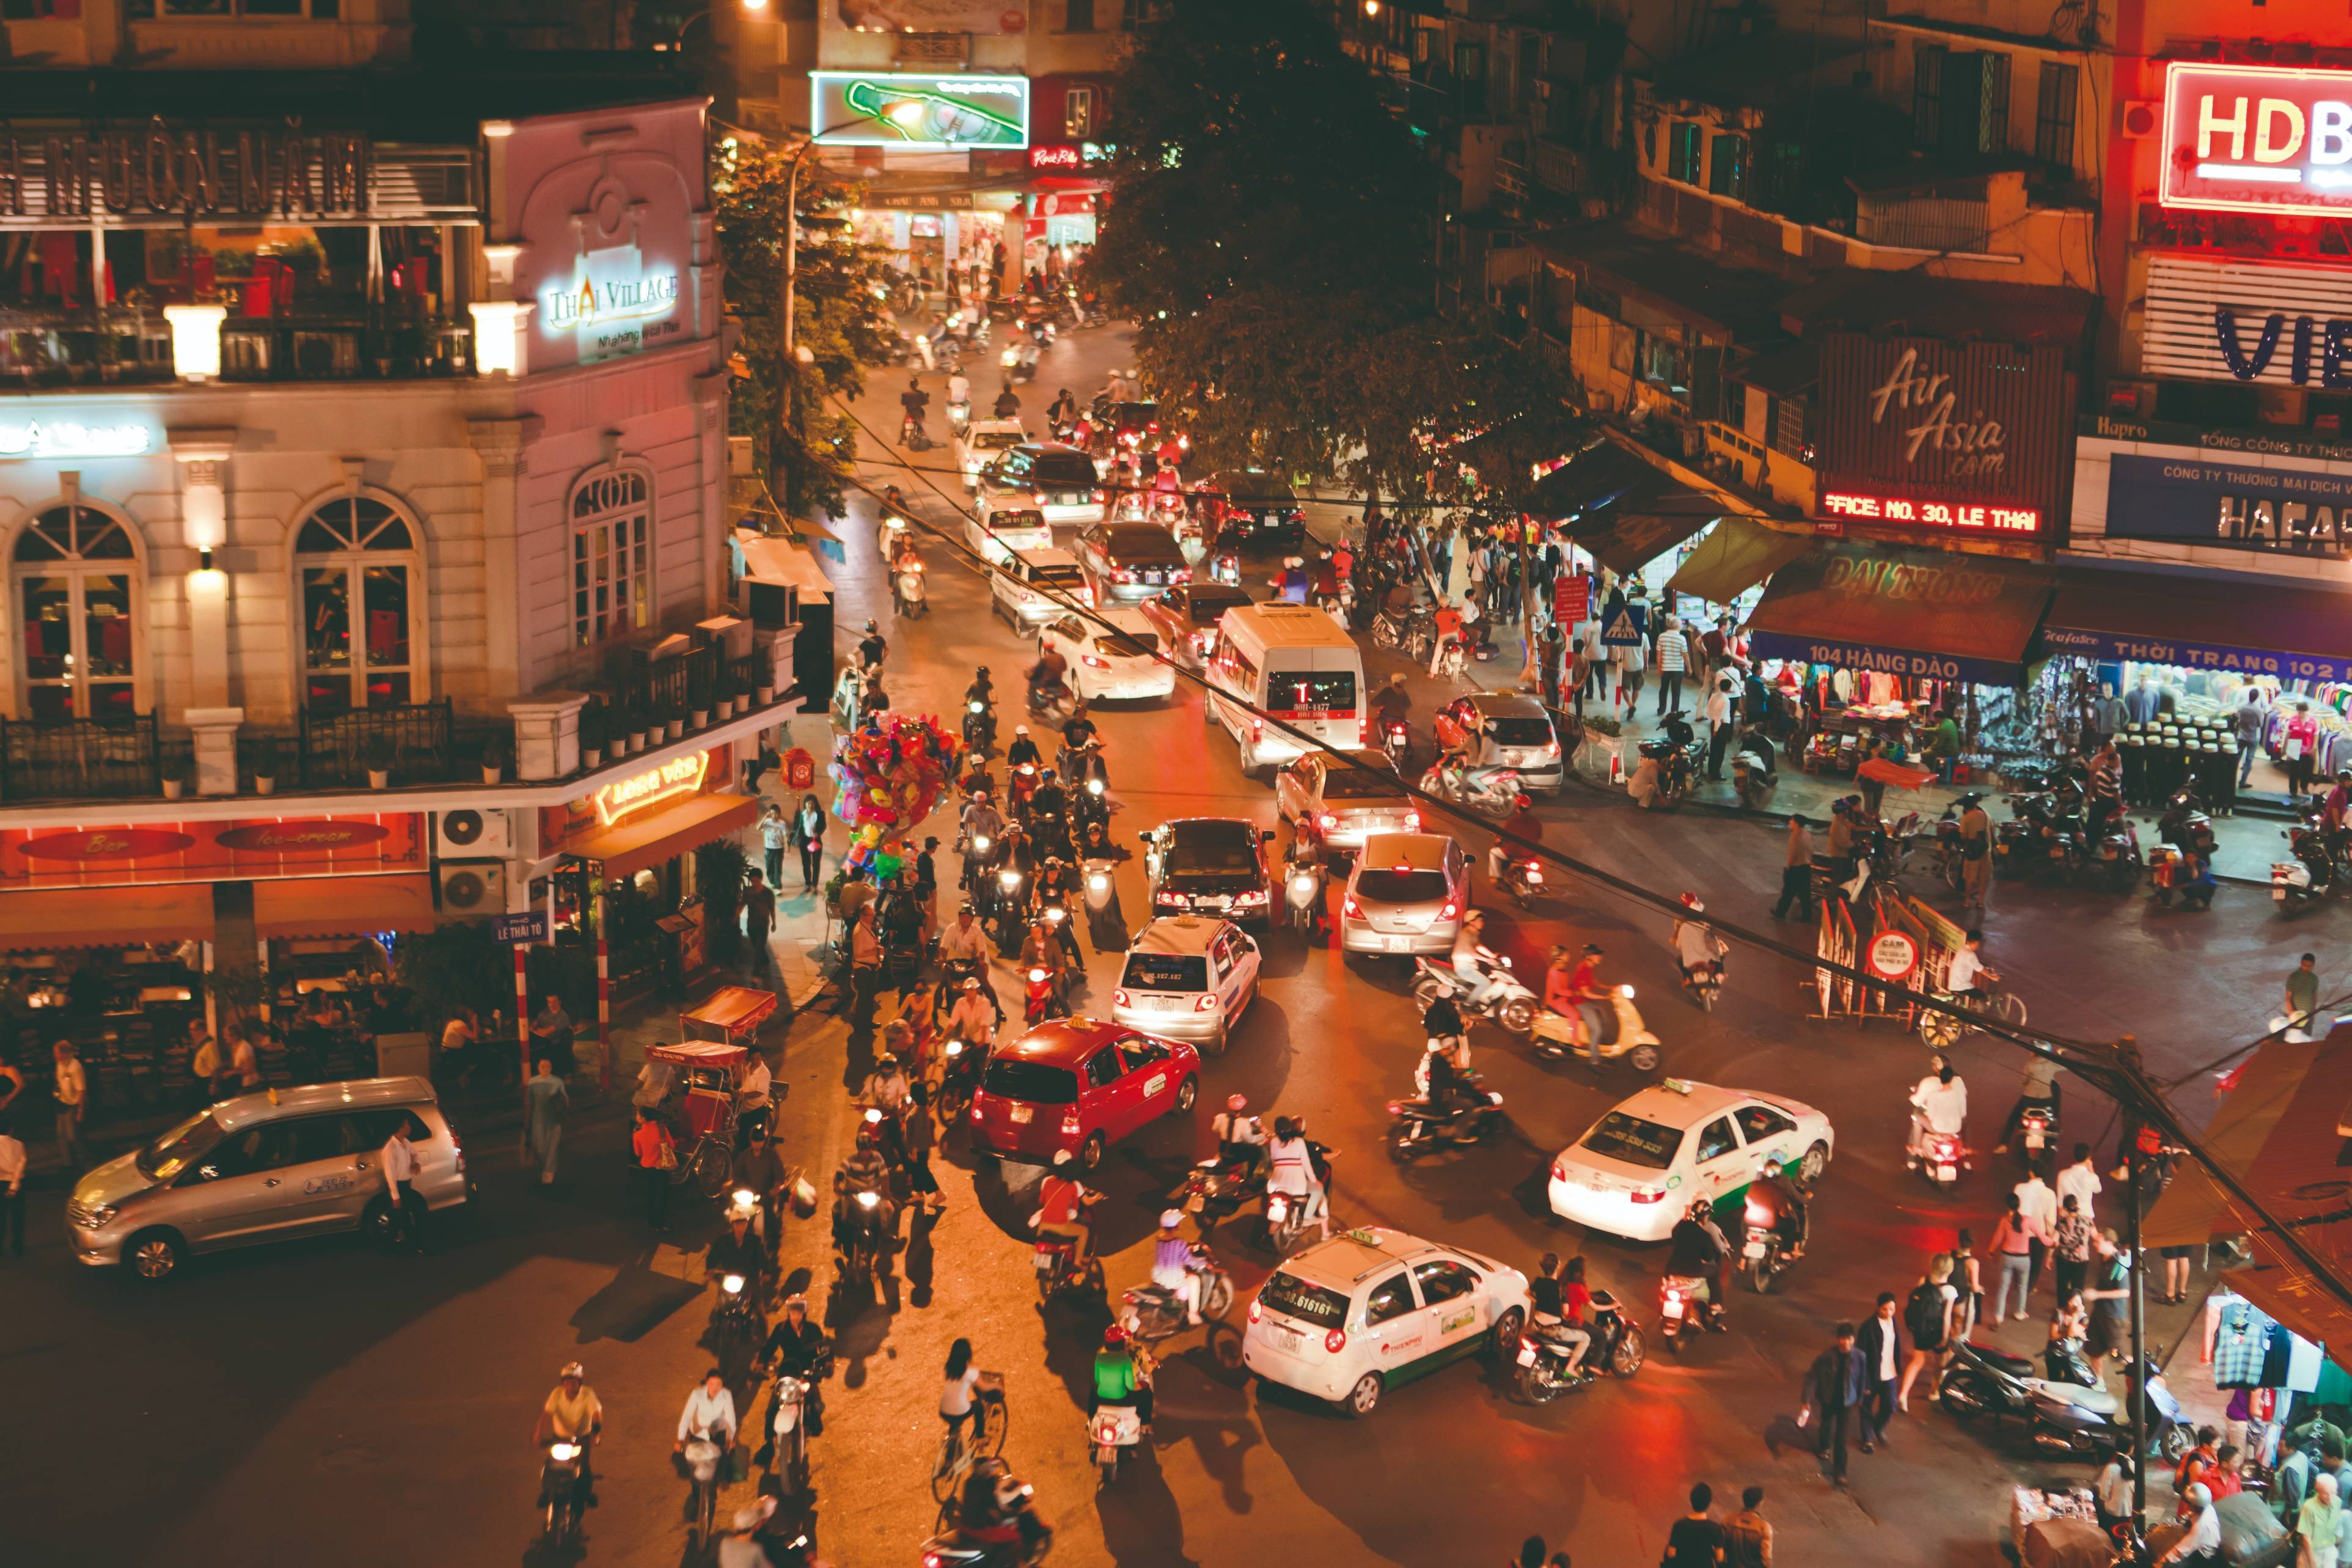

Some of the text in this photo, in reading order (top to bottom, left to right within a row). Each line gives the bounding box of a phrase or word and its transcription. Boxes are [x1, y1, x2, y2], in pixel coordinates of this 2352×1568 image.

[551, 274, 678, 324] THAI VILLAGE
[1870, 347, 1950, 424] Air
[1905, 391, 2006, 464] Asia
[2097, 416, 2147, 440] Hapro
[2297, 444, 2314, 455] TY
[2164, 465, 2200, 480] CÔNG
[2205, 470, 2222, 481] TY
[1885, 500, 1916, 521] NO.
[1922, 504, 1953, 526] 30,
[1958, 507, 1985, 526] LE
[1990, 509, 2036, 531] THAI
[1809, 645, 1959, 678] 104 HÀNG ĐÀO
[2187, 649, 2279, 672] TRANG
[2290, 661, 2334, 679] 102
[86, 833, 130, 855] Bar
[255, 829, 353, 848] Ice-cream
